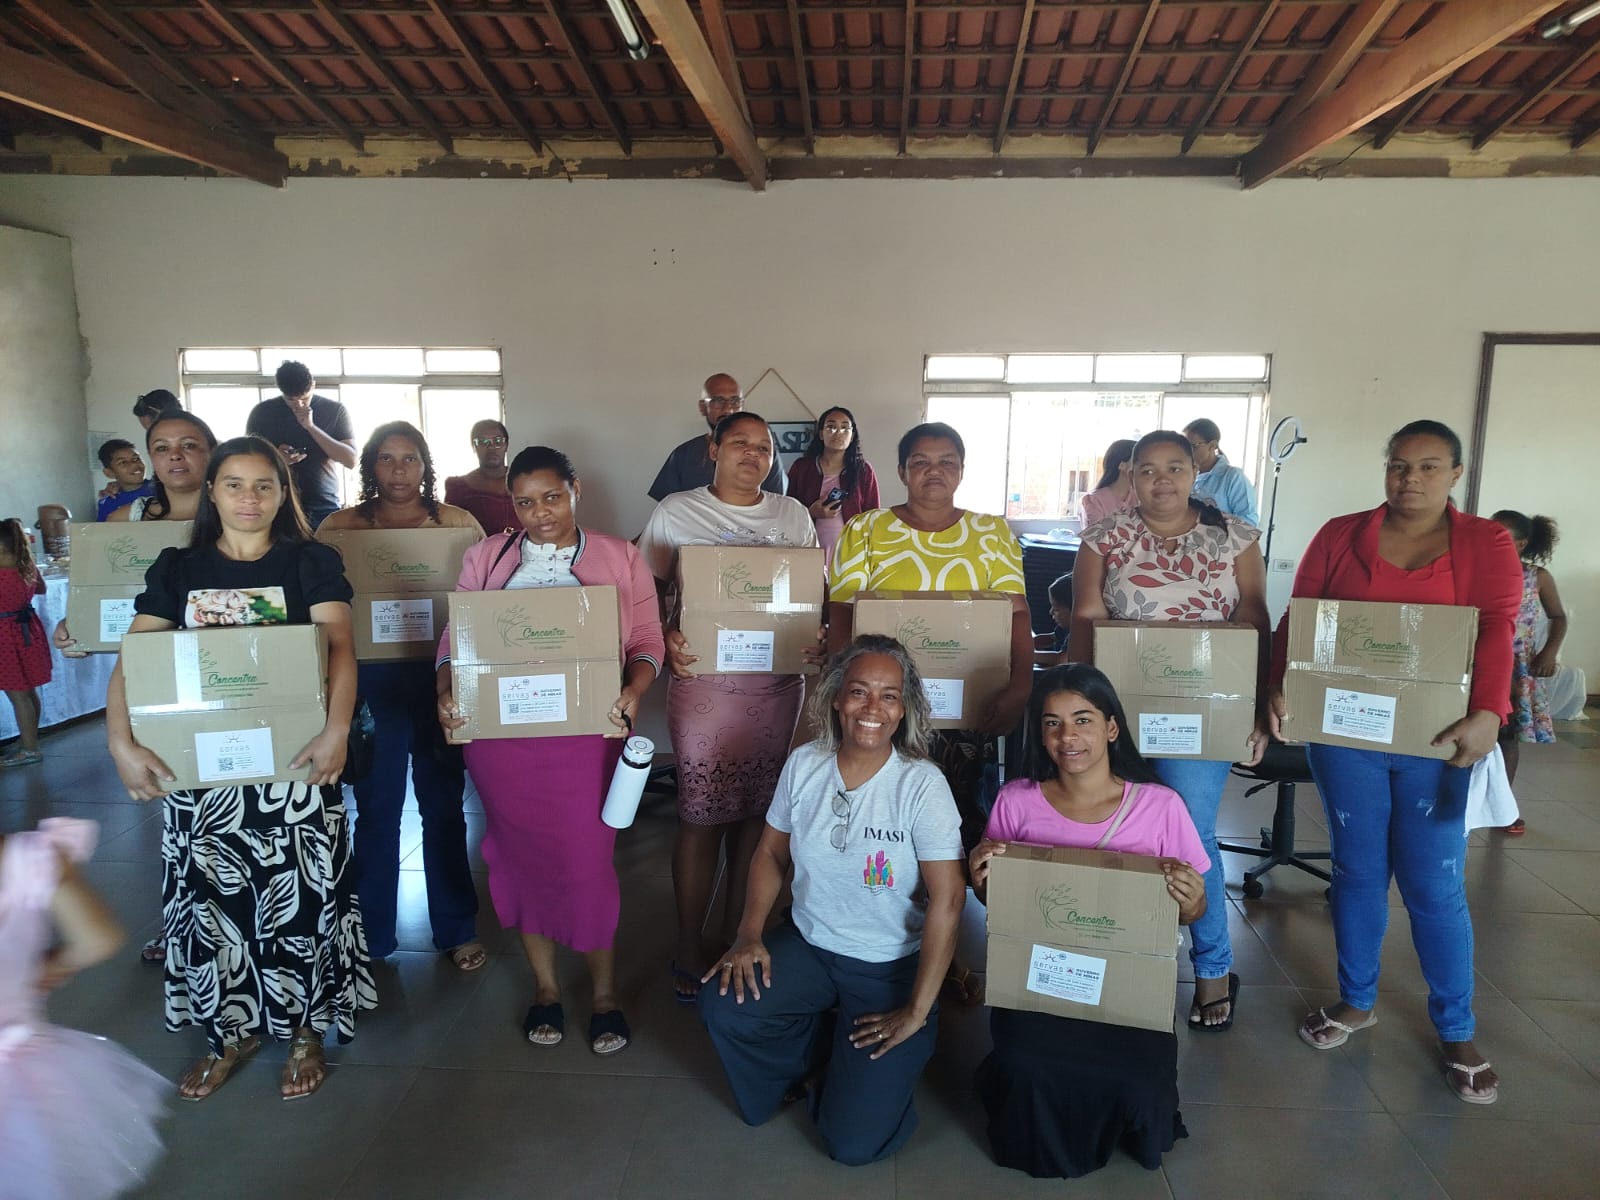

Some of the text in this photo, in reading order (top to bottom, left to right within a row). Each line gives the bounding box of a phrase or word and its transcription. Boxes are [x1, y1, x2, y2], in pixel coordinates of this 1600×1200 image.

[744, 582, 773, 592] Concent
[864, 827, 904, 842] IMASI
[1067, 911, 1116, 926] Concentra
